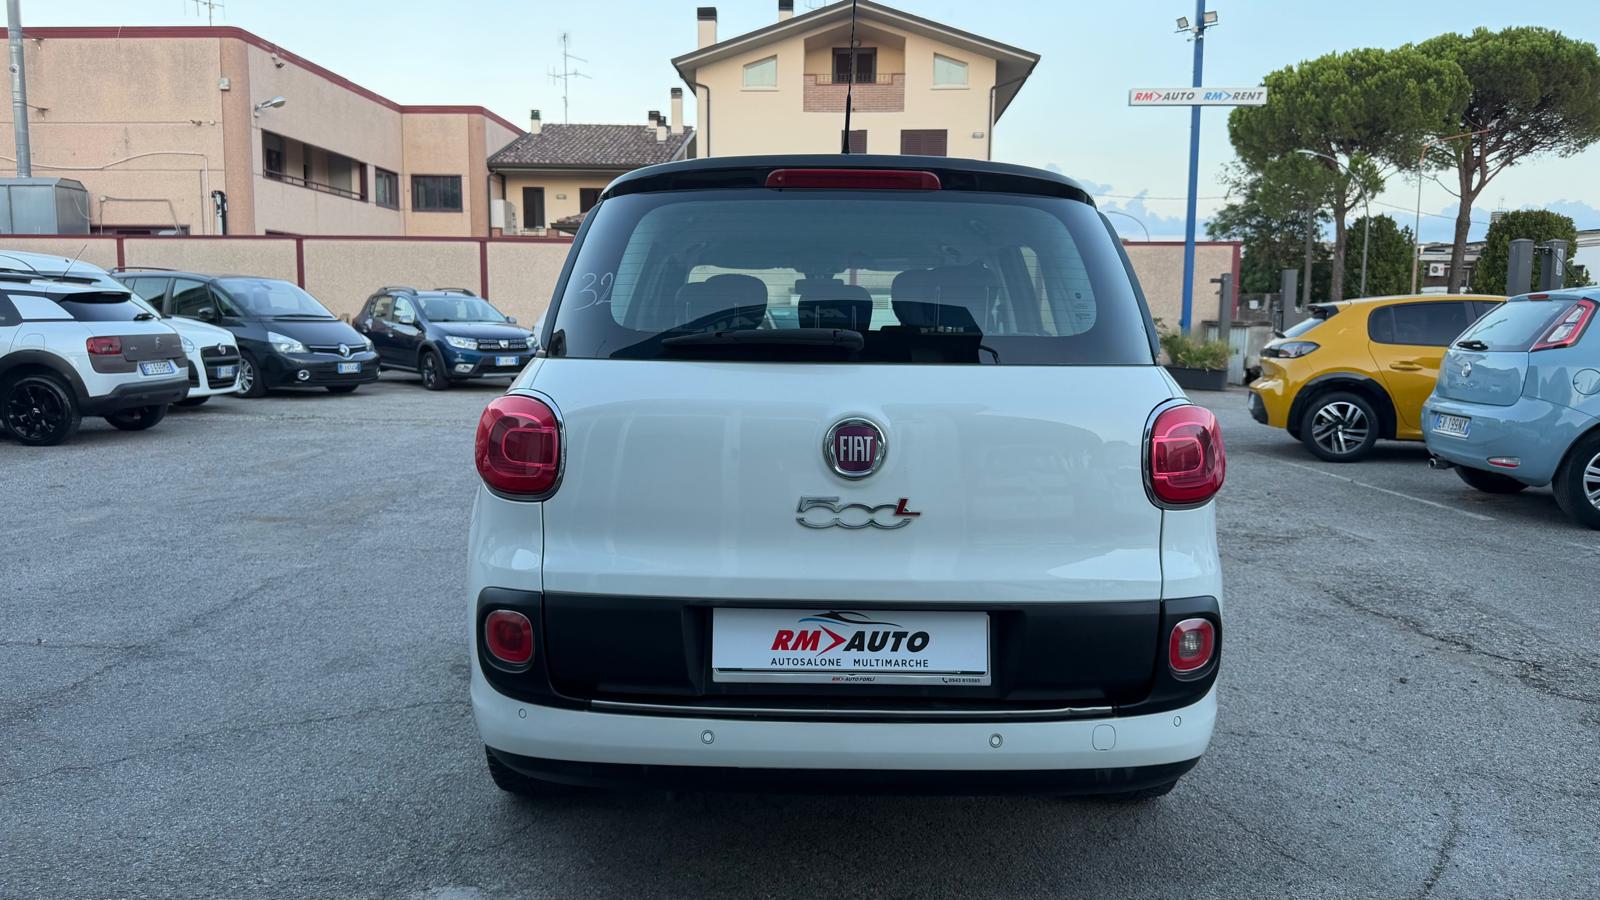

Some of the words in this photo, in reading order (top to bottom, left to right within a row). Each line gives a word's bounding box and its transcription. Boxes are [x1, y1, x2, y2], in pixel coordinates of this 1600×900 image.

[1162, 92, 1195, 101] AUTO
[1232, 91, 1263, 100] RENT
[574, 272, 613, 311] 32
[839, 435, 874, 462] FIAT
[843, 630, 930, 653] AUTO
[770, 657, 842, 667] AUTOSALONE
[853, 658, 929, 668] MULTIMARCHE
